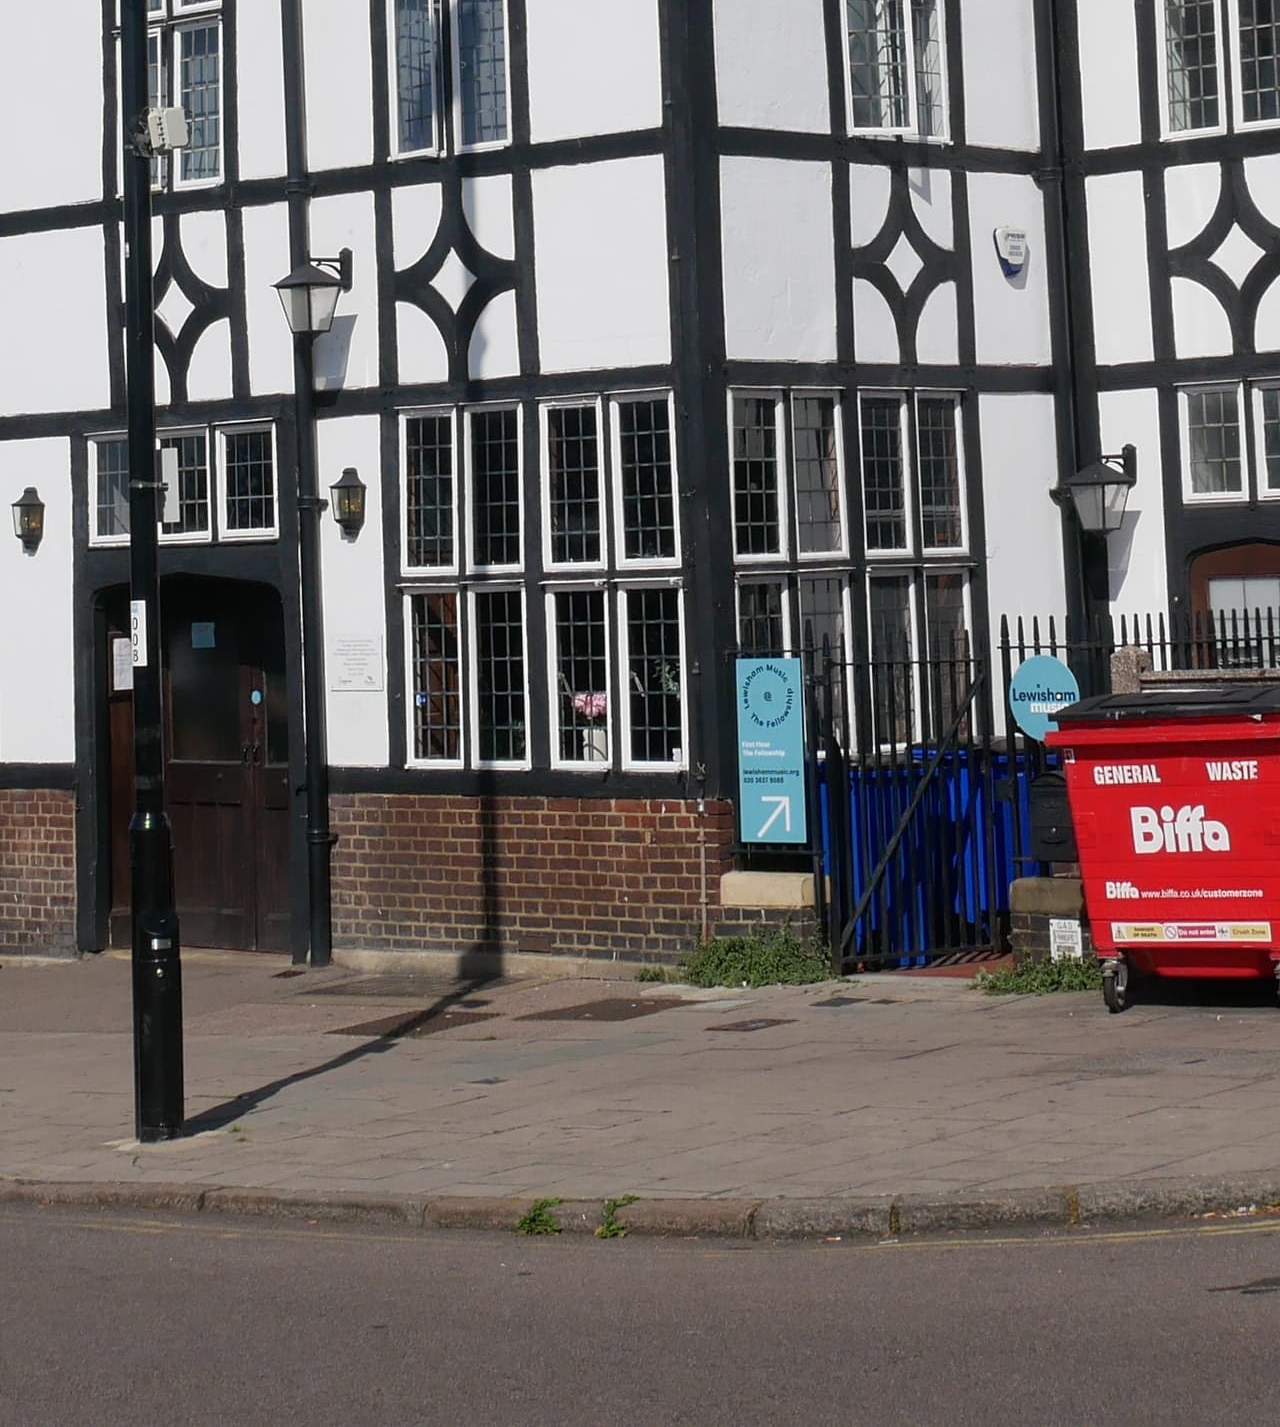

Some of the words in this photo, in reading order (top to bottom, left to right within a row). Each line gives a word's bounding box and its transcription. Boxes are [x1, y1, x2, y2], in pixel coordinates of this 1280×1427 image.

[742, 665, 764, 710] Lewisham
[766, 663, 788, 683] Music
[1012, 684, 1076, 702] Lewisham
[751, 712, 764, 727] The
[766, 687, 794, 728] Fellowship
[1093, 764, 1161, 785] GENERAL
[1205, 760, 1258, 781] WASTE
[1130, 805, 1230, 854] Biffa
[1105, 881, 1139, 899] Biffa
[1141, 888, 1264, 899] www.biffa.co.uk/customerzone
